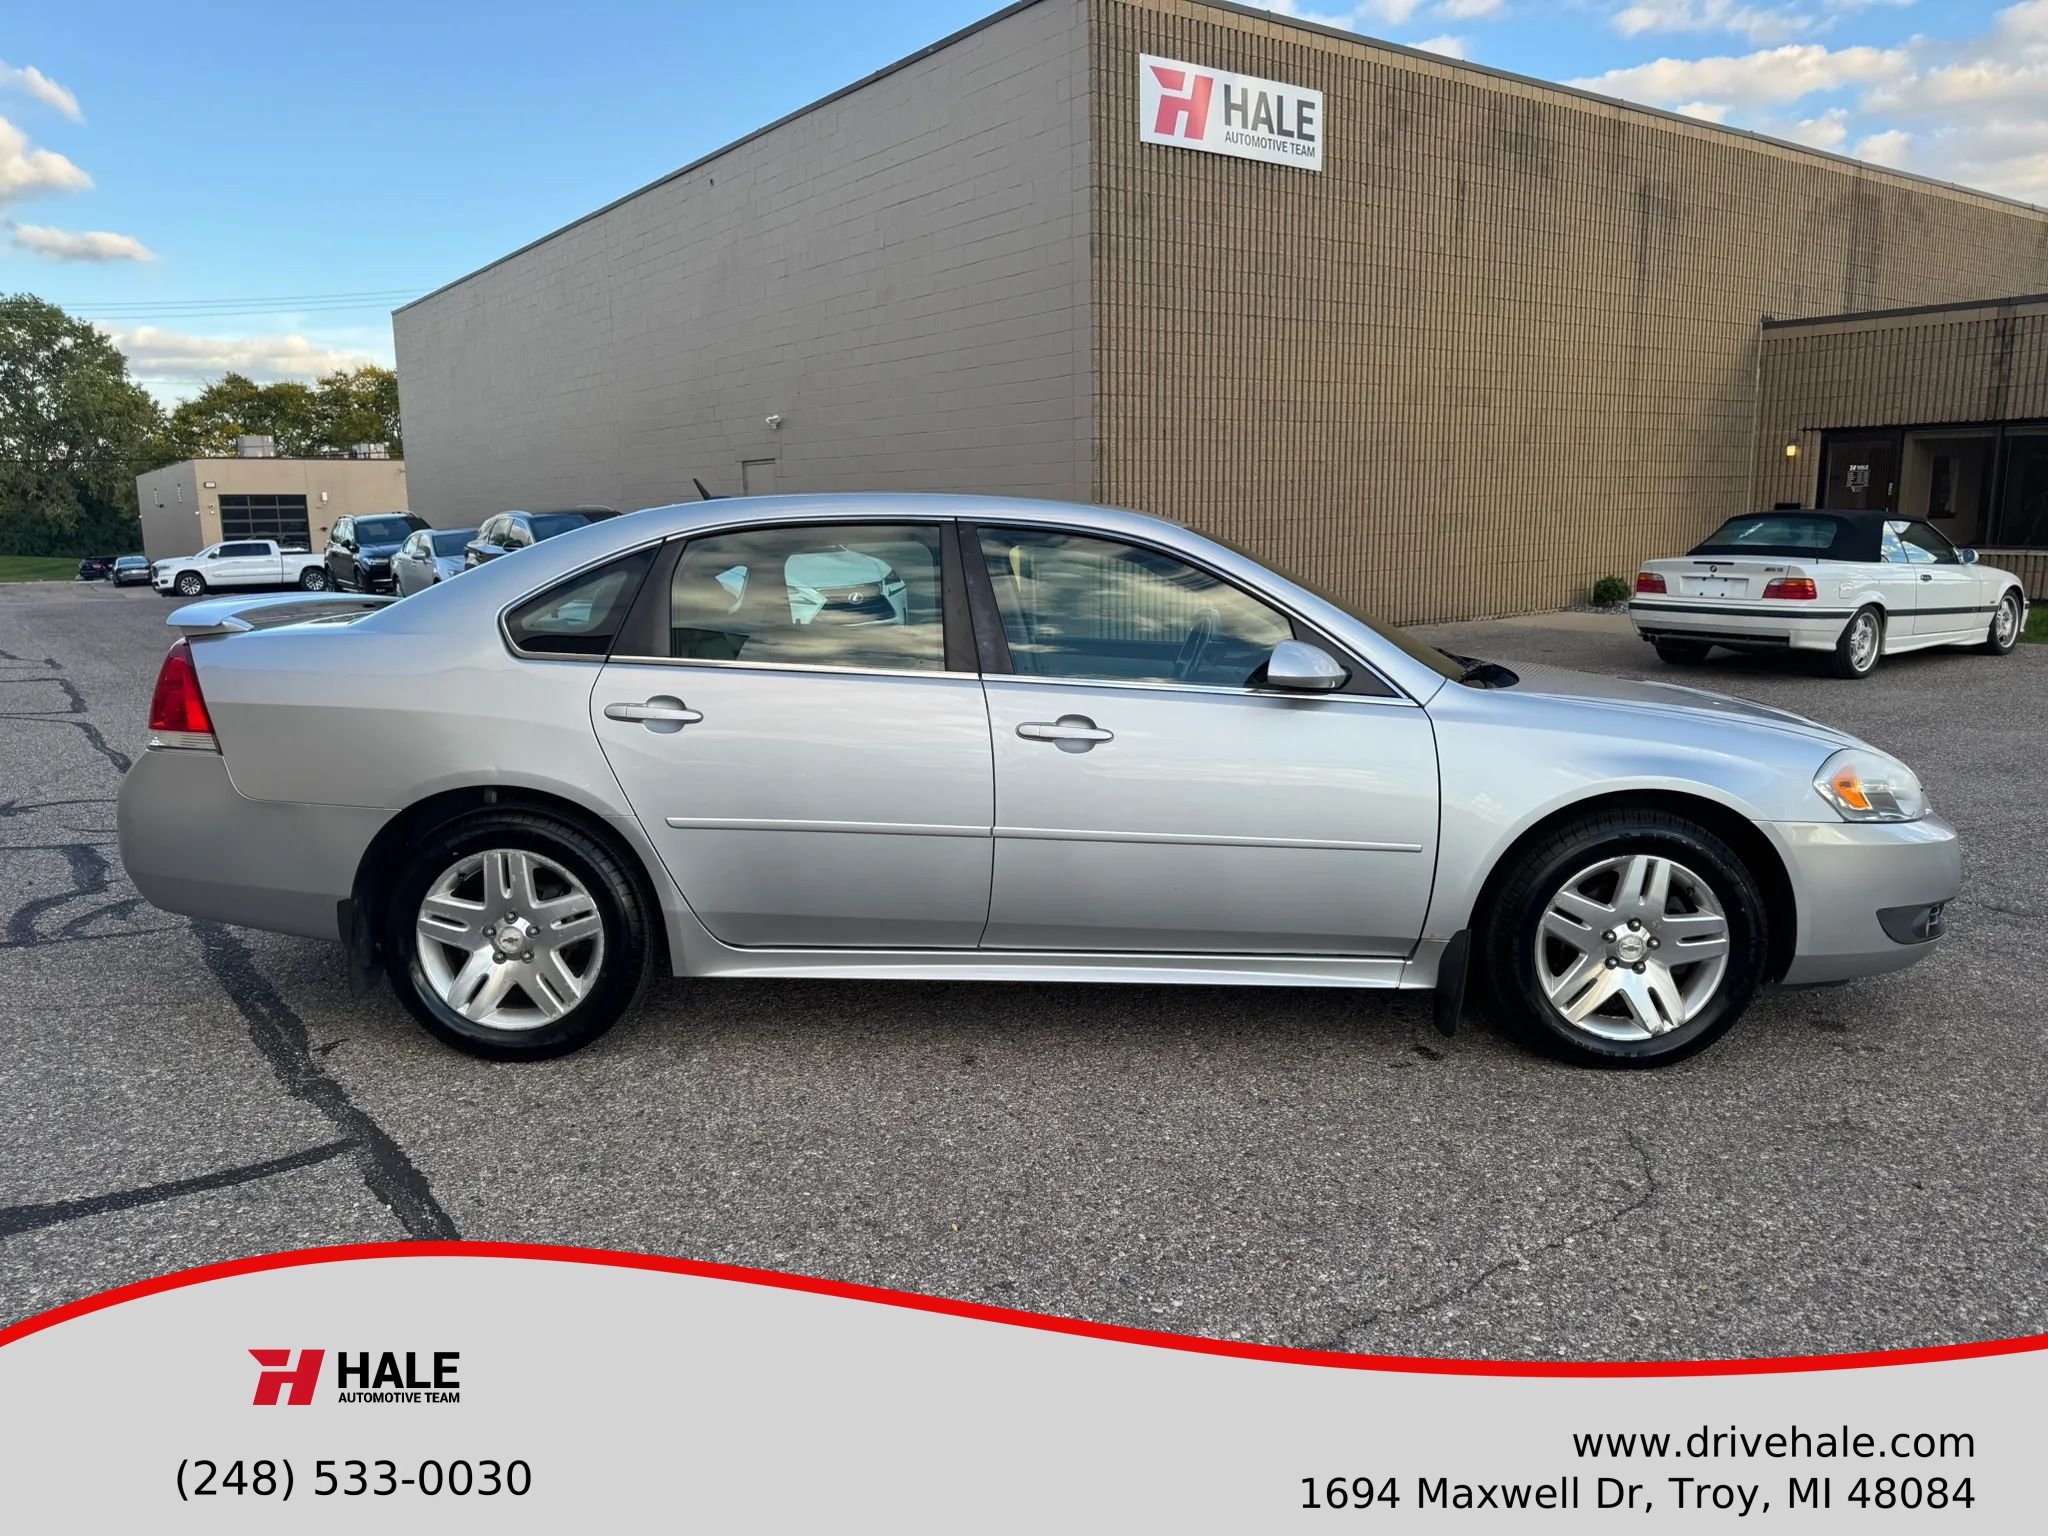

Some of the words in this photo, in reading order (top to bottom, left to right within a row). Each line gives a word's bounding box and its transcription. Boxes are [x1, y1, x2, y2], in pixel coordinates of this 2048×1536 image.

[1223, 83, 1316, 142] HALE
[1224, 130, 1288, 153] AUTOMOTIVE
[1289, 142, 1316, 158] TEAM
